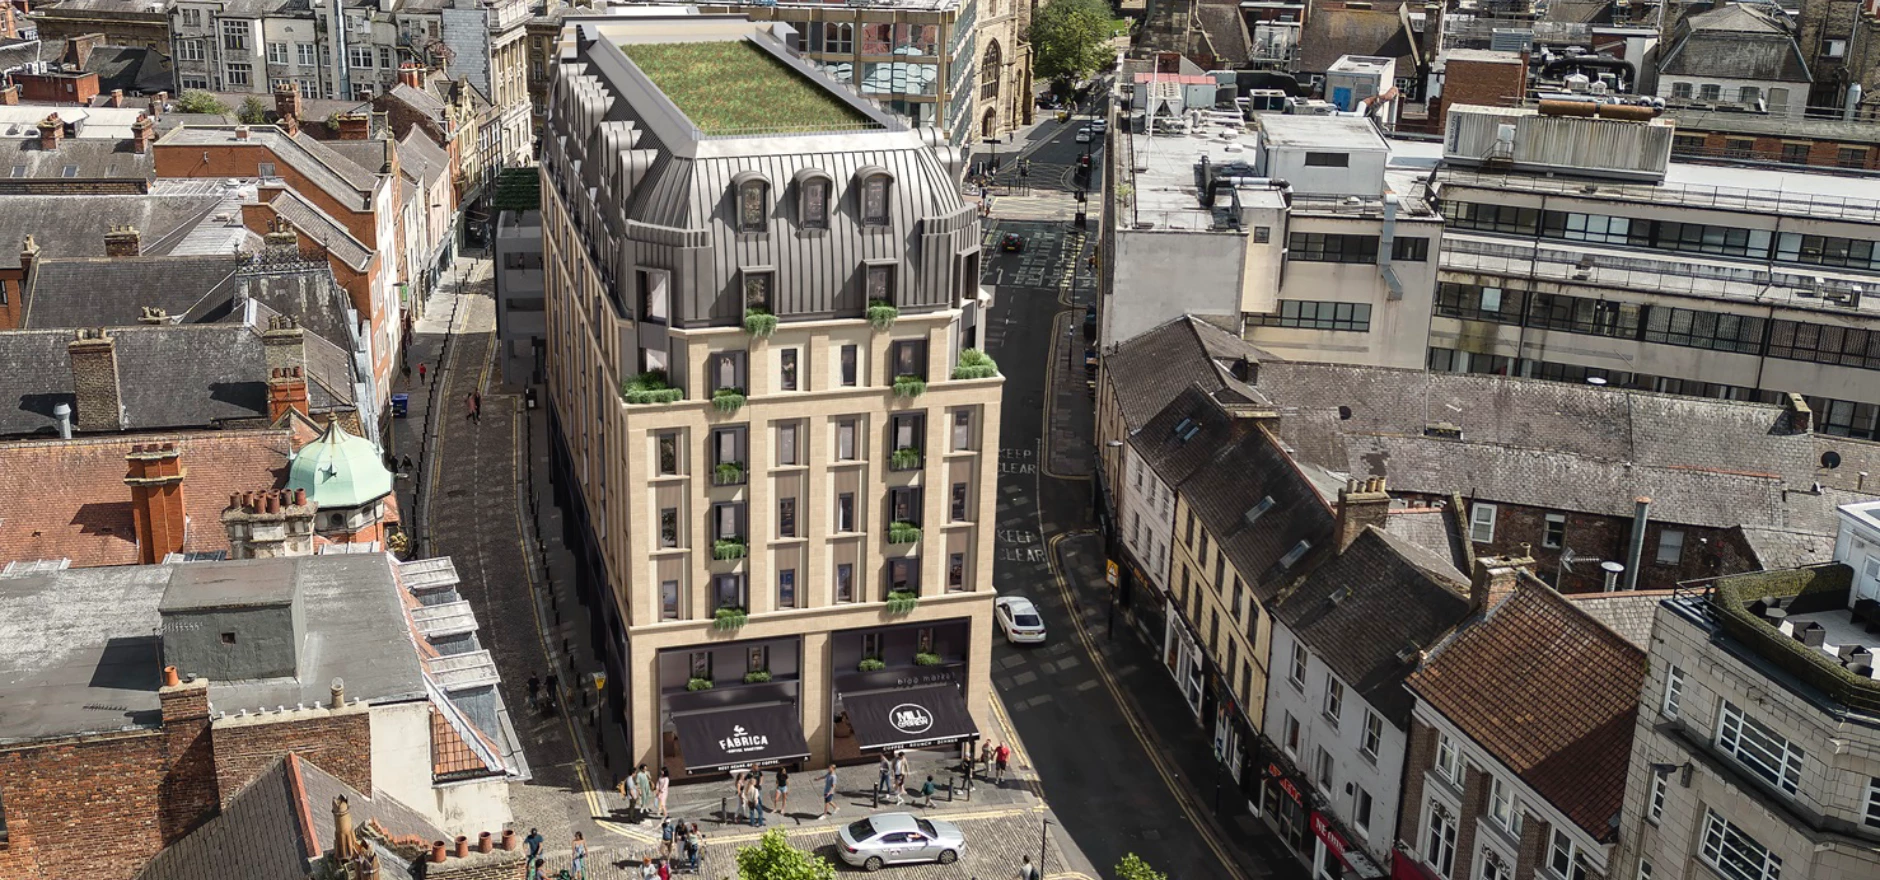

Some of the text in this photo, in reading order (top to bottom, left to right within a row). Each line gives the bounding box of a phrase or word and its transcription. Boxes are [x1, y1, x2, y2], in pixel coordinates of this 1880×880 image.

[998, 448, 1032, 459] KEEP
[997, 529, 1034, 543] KEEP
[999, 547, 1046, 562] CLEAR
[896, 709, 922, 721] MILL
[719, 735, 769, 750] FABRICA
